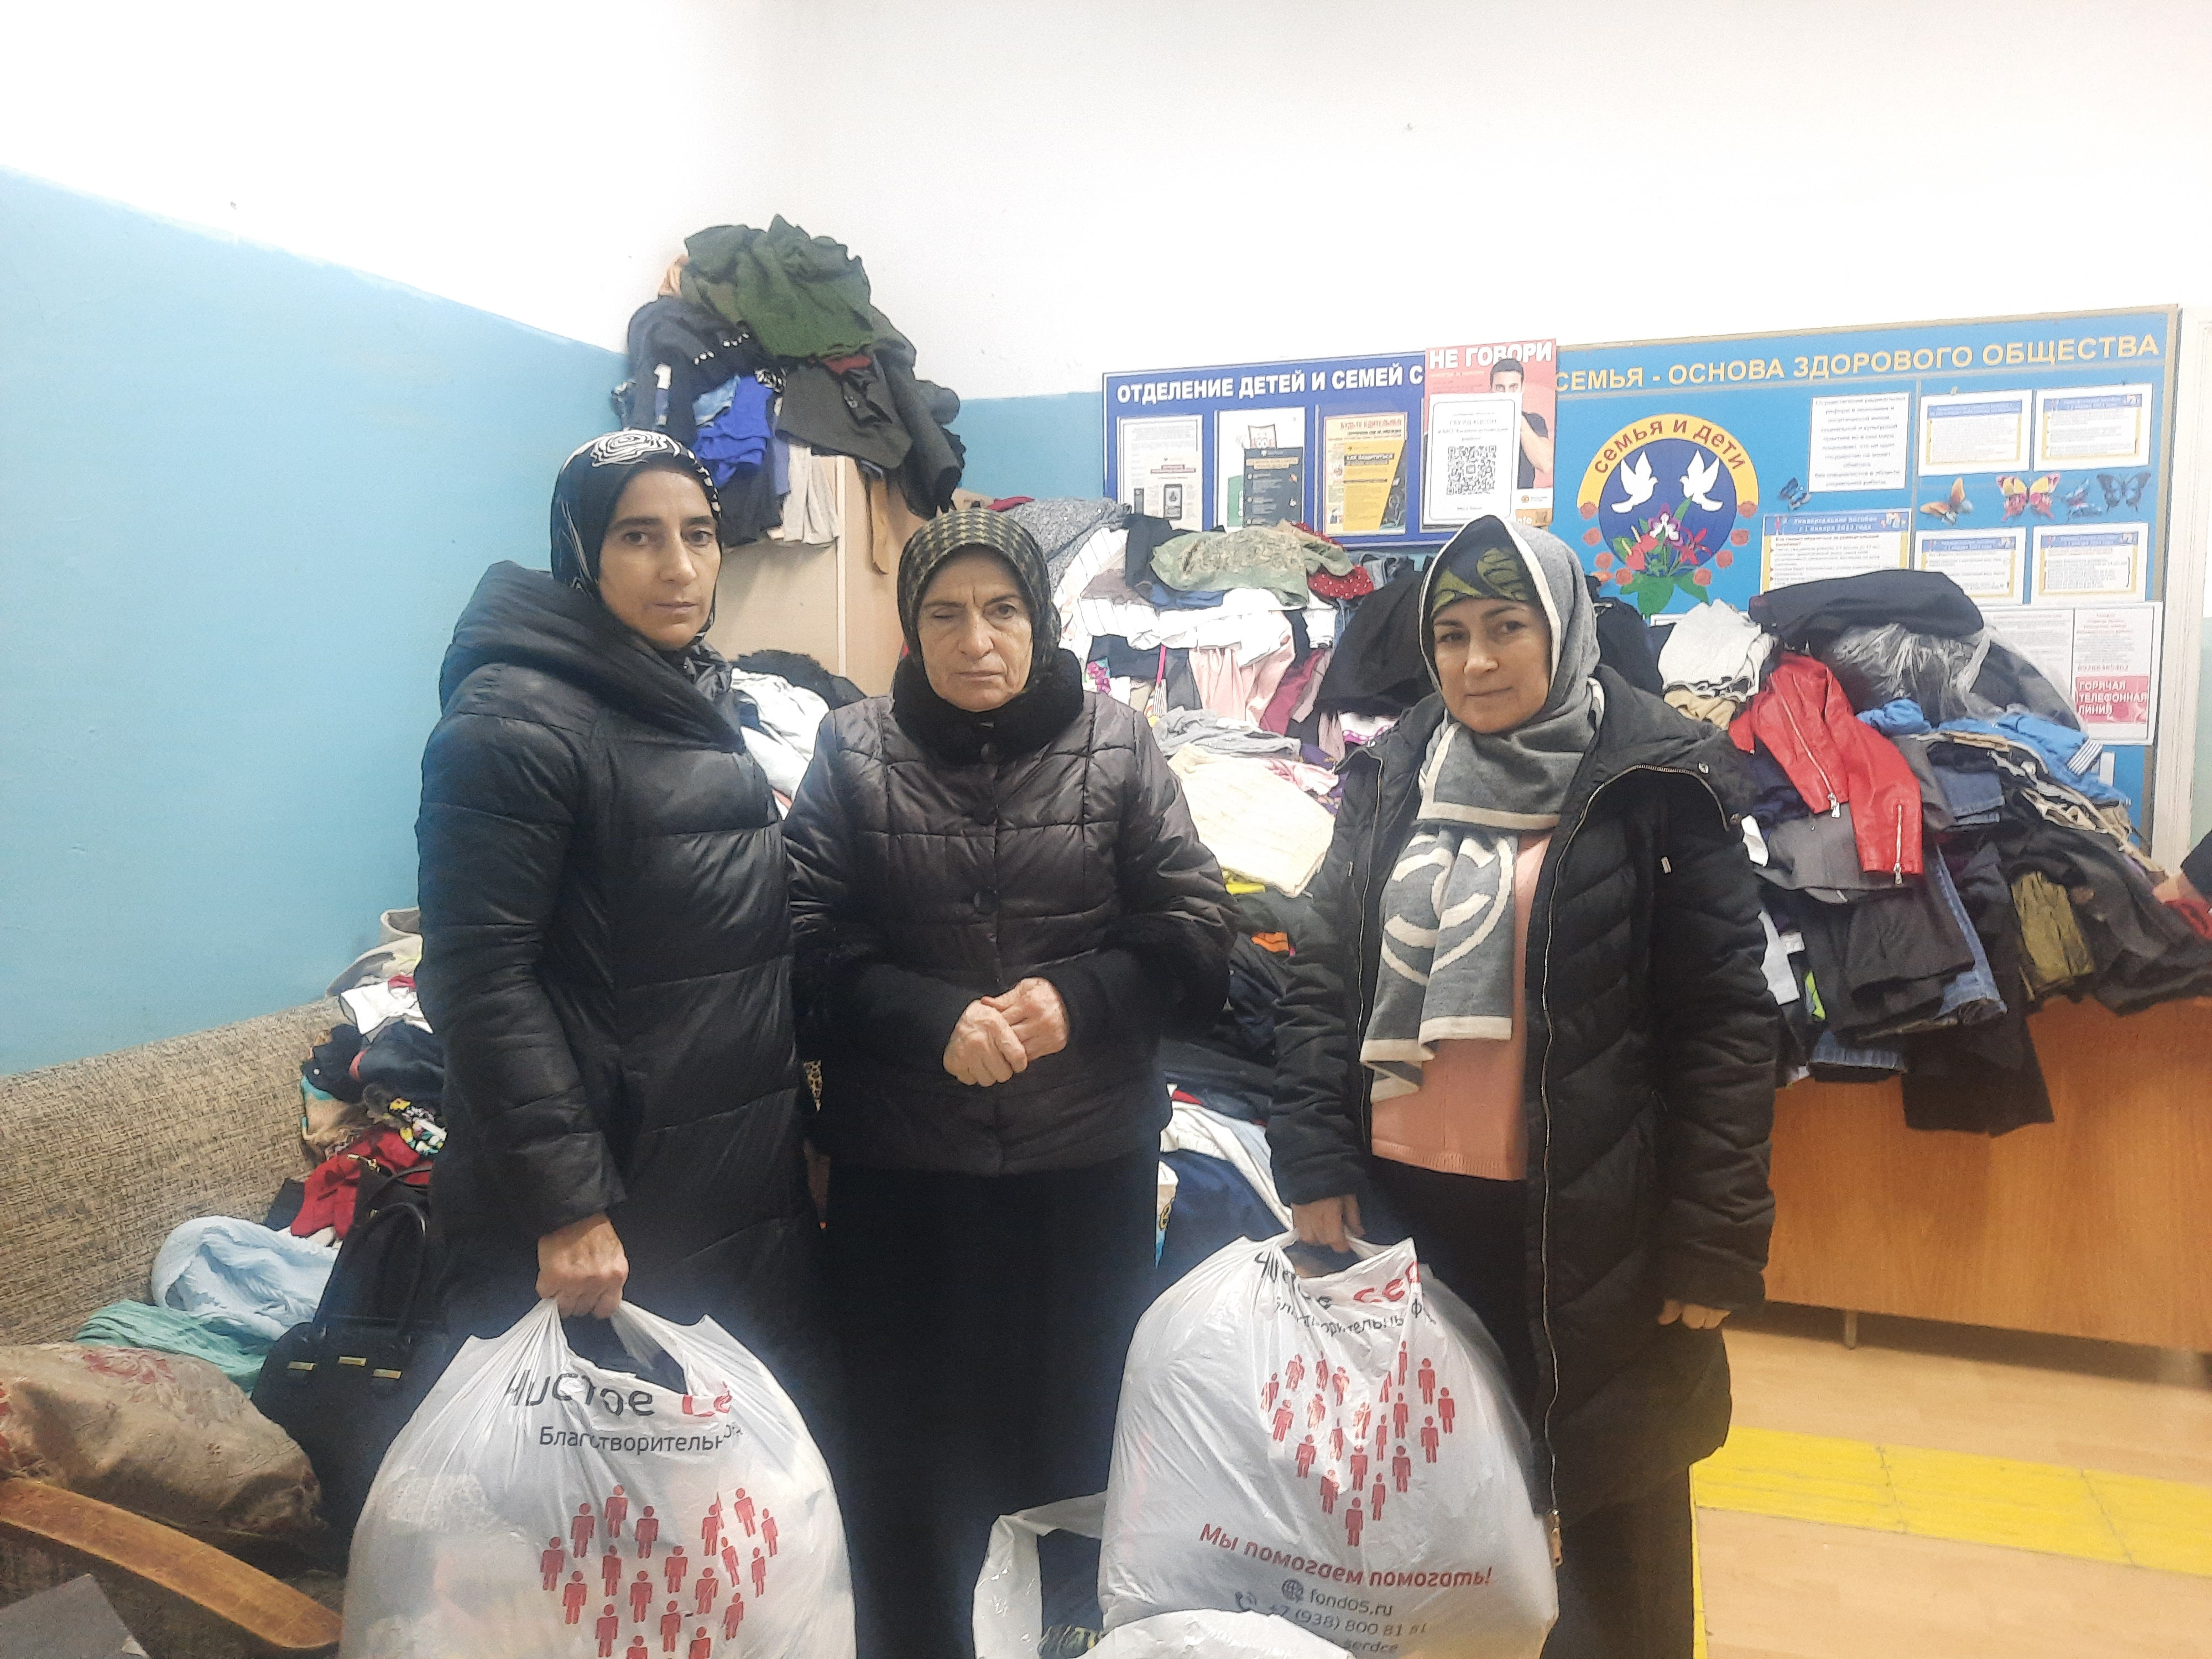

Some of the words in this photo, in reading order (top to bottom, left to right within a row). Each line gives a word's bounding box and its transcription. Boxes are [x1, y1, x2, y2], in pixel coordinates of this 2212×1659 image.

[1429, 349, 1459, 369] НЕ
[1465, 341, 1552, 368] ГОВОРИ
[1557, 367, 1644, 392] СЕМЬЯ
[1668, 358, 1785, 385] ОСНОВА
[1793, 346, 1973, 380] ЗДОРОВОГО
[1982, 334, 2159, 366] ОБЩЕСТВА
[1117, 378, 1234, 405] ОТДЕЛЕНИЕ
[1239, 369, 1305, 399] ДЕТЕЙ
[1311, 373, 1326, 392] И
[1332, 363, 1402, 390] СЕМЕЙ
[1409, 365, 1424, 385] С
[2079, 680, 2126, 691] ГОРЯЧАЯ
[2078, 692, 2148, 703] ТЕЛЕФОННАЯ
[2078, 704, 2112, 715] ЛИНИЯ
[1199, 1524, 1240, 1551] Мы
[1244, 1541, 1364, 1584] помогаем
[1369, 1567, 1494, 1588] помогать!
[1345, 1620, 1378, 1635] 800
